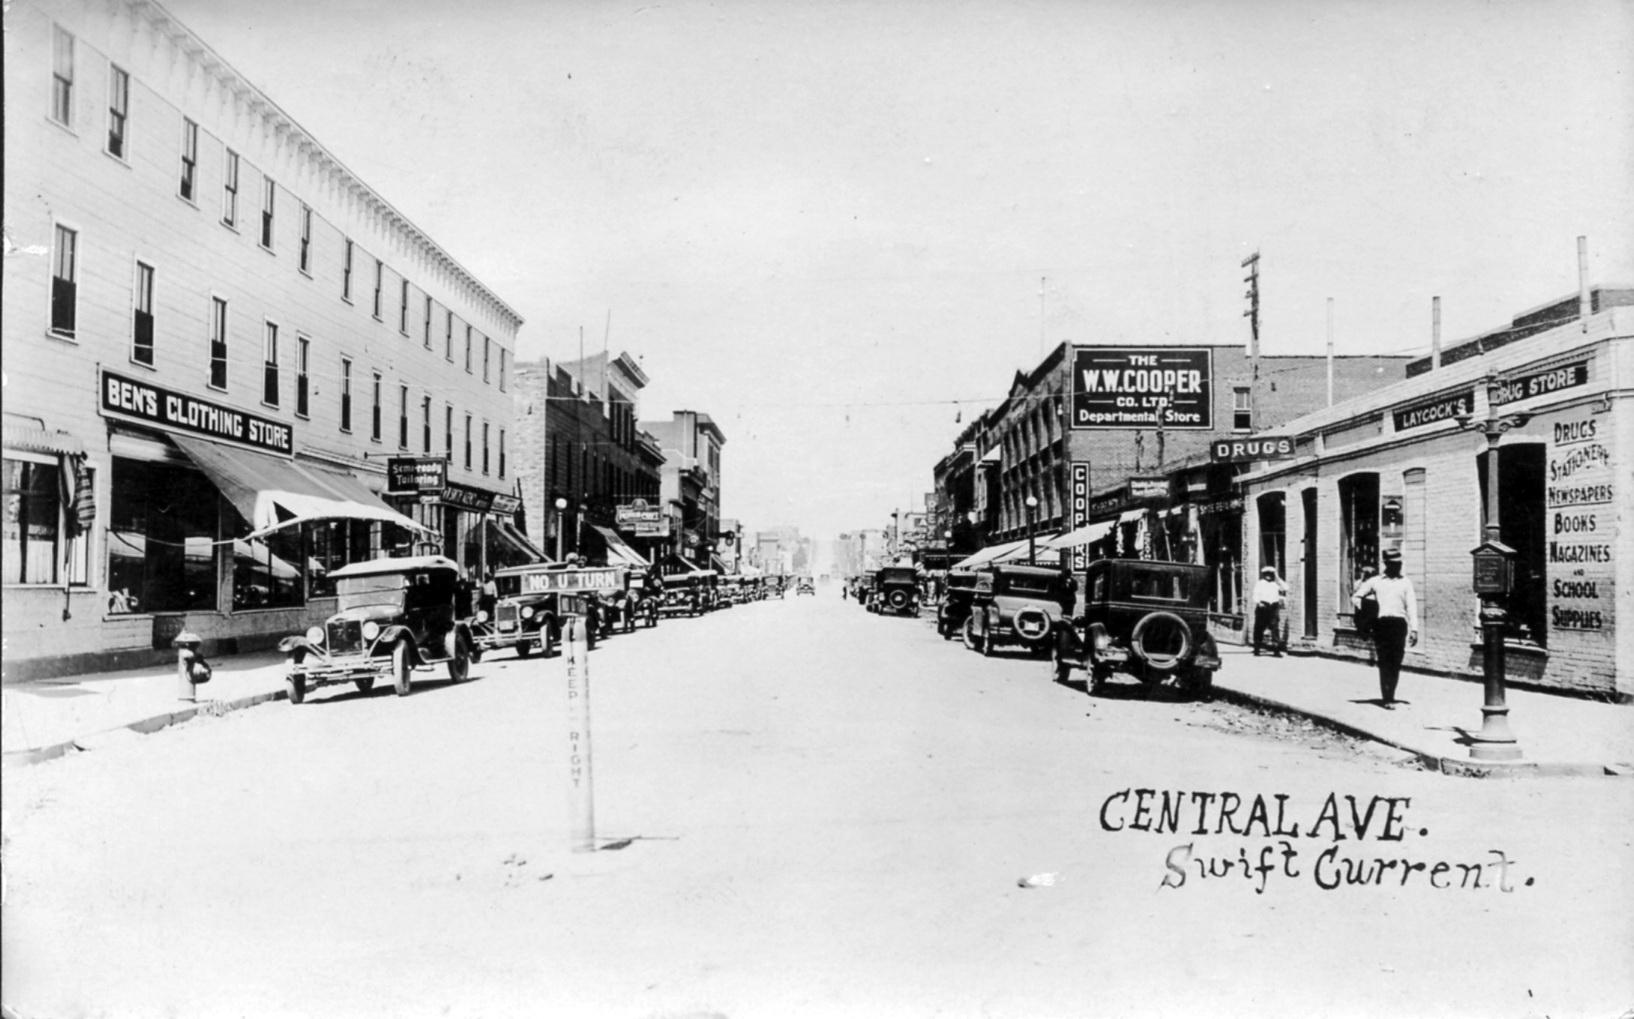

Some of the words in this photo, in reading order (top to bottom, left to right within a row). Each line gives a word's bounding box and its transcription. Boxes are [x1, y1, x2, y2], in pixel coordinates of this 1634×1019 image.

[1128, 355, 1158, 366] THE
[1116, 397, 1139, 408] CO.
[1142, 397, 1173, 408] LTD.
[1403, 398, 1467, 427] LAYCOCK'S
[1529, 366, 1576, 395] STORE
[107, 377, 158, 417] BEN'S
[166, 395, 243, 438] CLOTHING
[249, 417, 290, 449] STORE
[1079, 409, 1159, 424] Departmental
[1165, 409, 1201, 423] Store
[1217, 440, 1291, 458] DRUGS
[396, 473, 438, 486] Tailoring
[529, 575, 550, 590] NO
[558, 574, 568, 588] U
[577, 571, 615, 588] TURN
[569, 731, 581, 788] RIGHT
